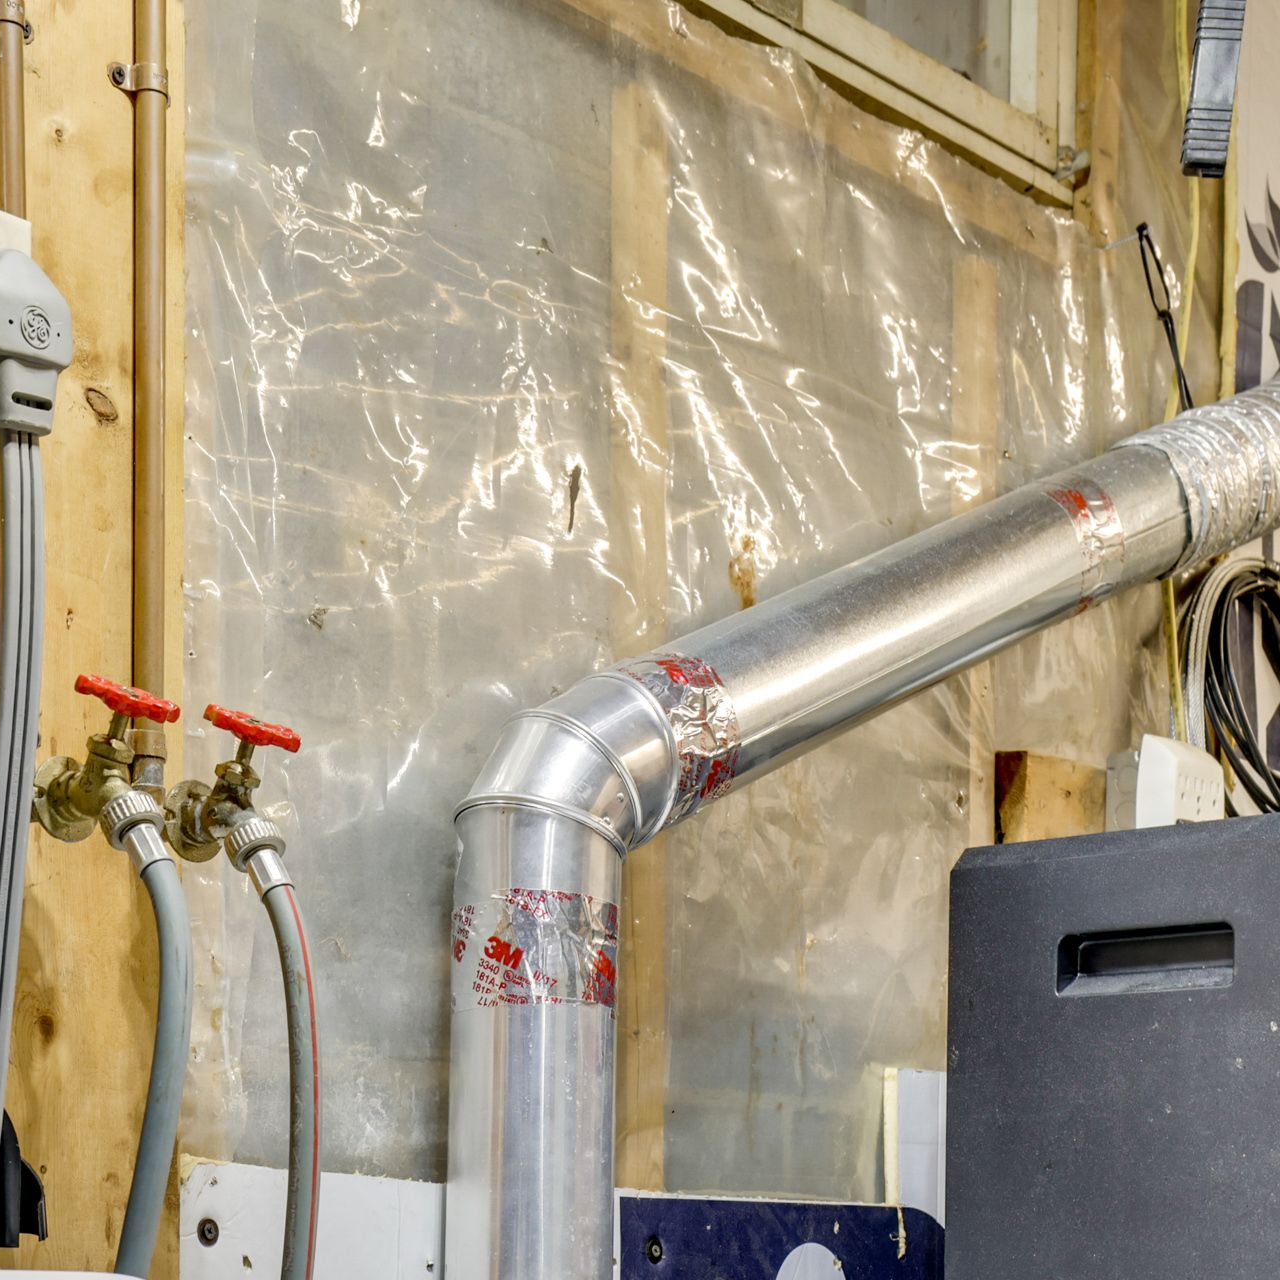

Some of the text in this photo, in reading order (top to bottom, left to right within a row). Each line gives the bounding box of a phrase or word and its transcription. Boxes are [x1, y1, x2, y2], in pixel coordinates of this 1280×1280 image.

[484, 935, 525, 971] 3M
[477, 957, 501, 975] 3340
[474, 969, 508, 991] 181A-P
